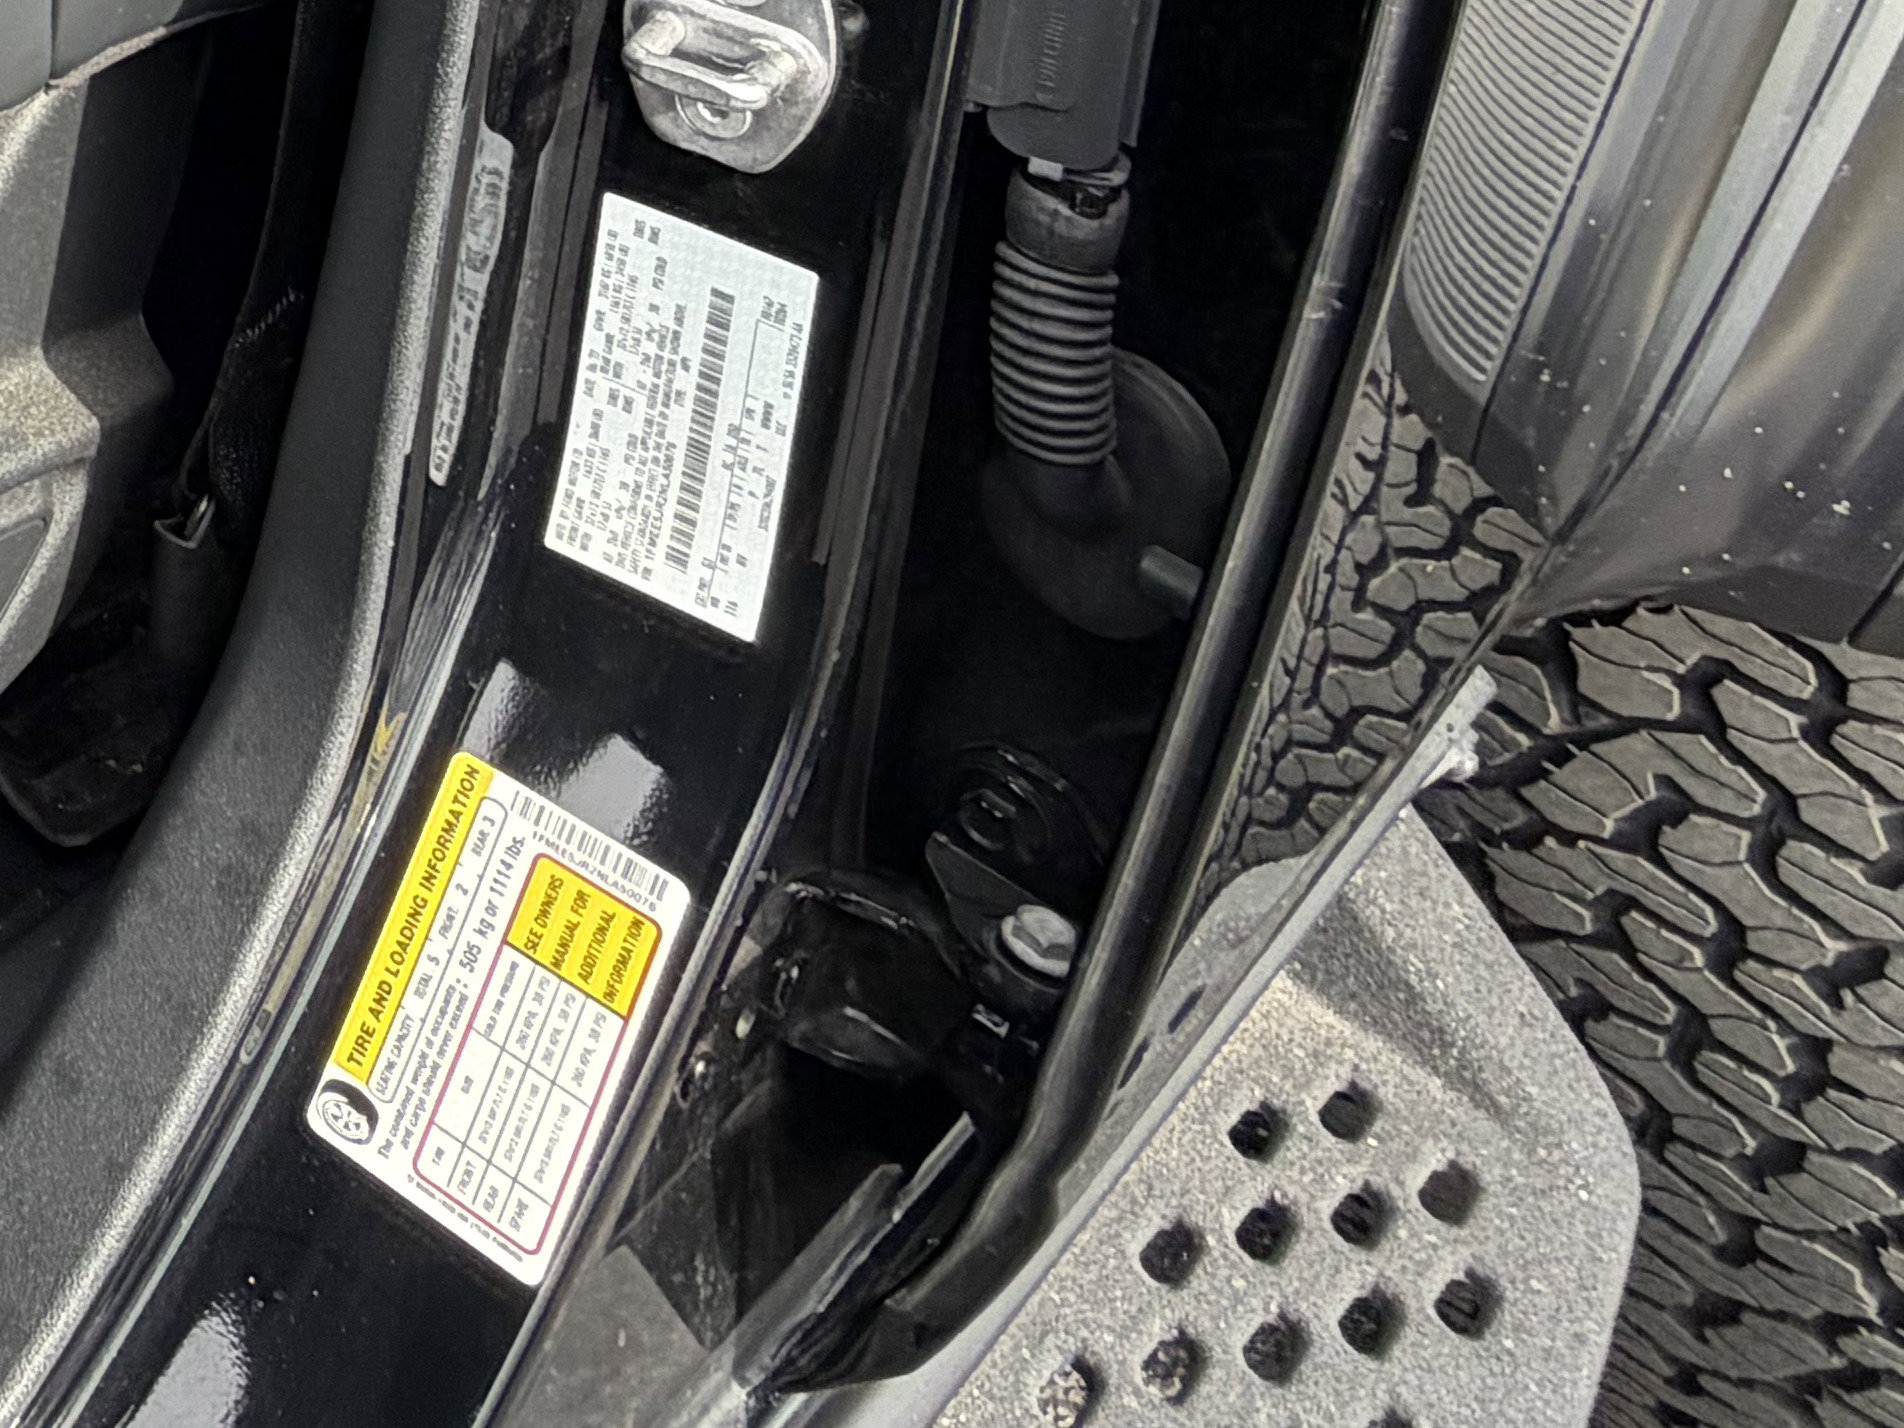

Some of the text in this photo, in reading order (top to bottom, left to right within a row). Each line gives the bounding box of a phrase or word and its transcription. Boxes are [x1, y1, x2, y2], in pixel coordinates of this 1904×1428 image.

[480, 814, 495, 827] 3
[345, 763, 480, 1067] TIRE AND LOADING INFORMATION
[454, 882, 469, 896] 2
[457, 835, 526, 973] 505 kg or 1114 lbs.
[522, 873, 564, 955] SEE OWNERS
[549, 888, 591, 971] MANUAL FOR
[576, 909, 616, 985] ADDITIONAL
[601, 915, 645, 1004] INFORMATION
